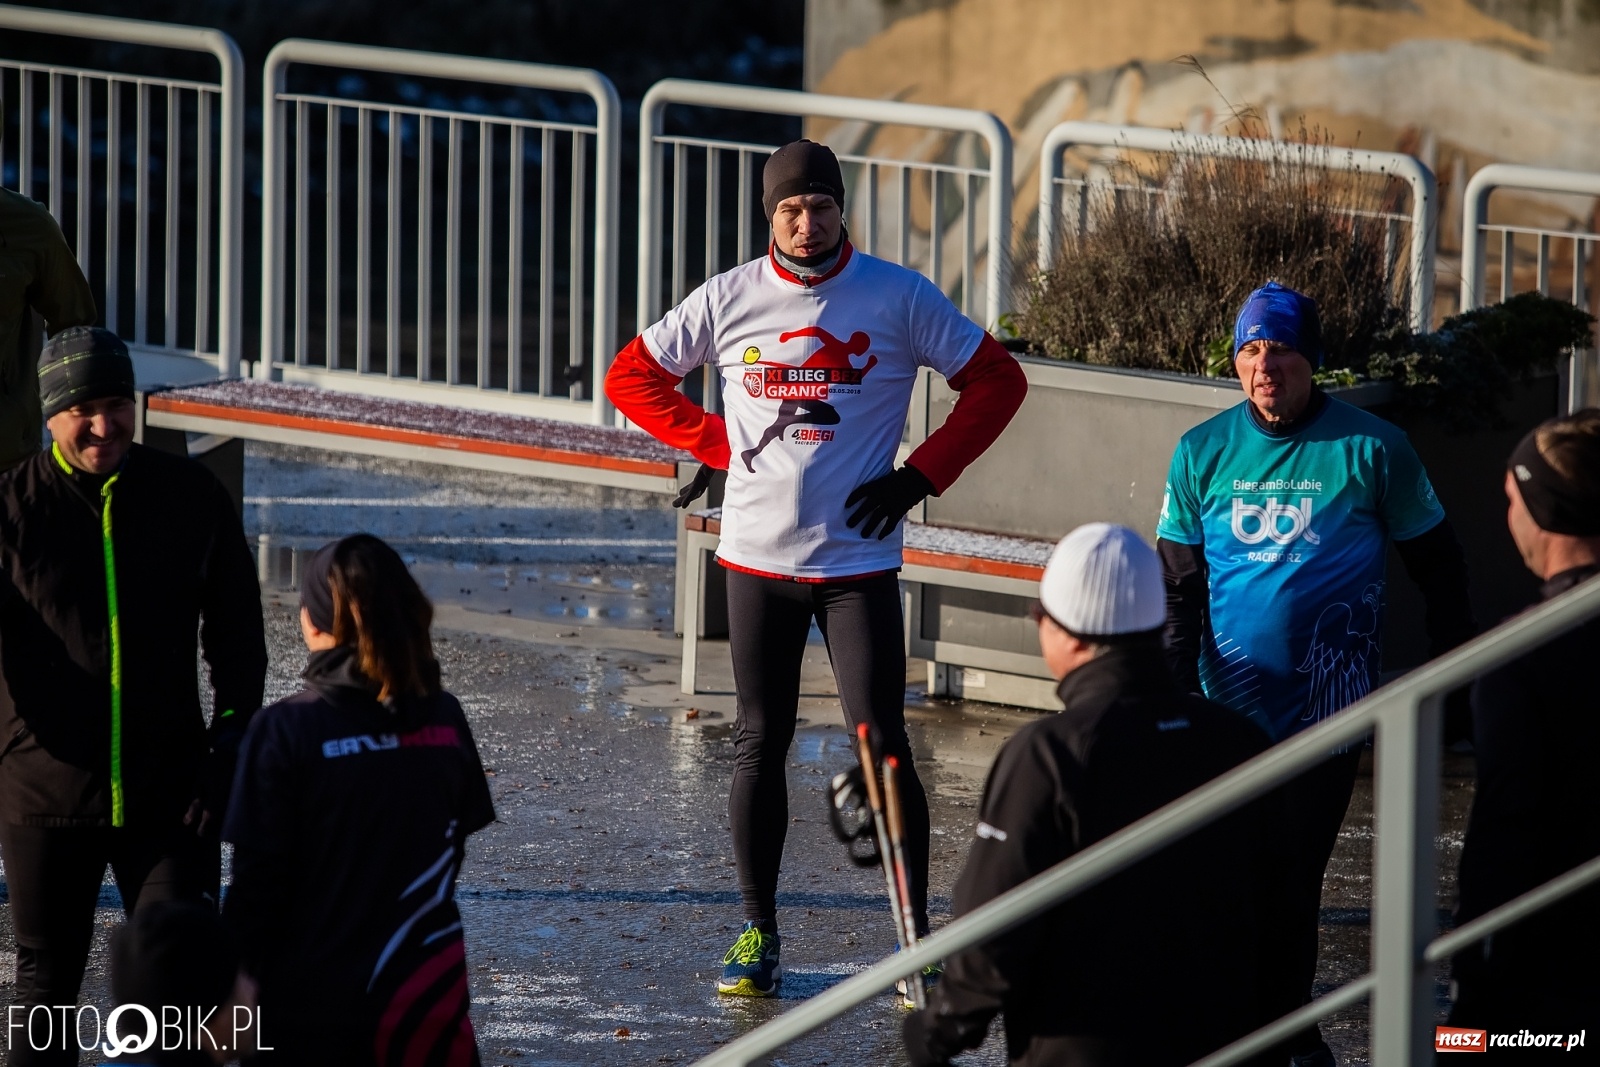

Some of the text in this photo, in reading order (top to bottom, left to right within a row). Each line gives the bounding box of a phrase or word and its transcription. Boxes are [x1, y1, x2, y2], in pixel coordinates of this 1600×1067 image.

[766, 369, 861, 382] XI BIEG BEZ
[767, 385, 827, 398] GRANIC
[1233, 479, 1323, 493] BiegamBoLubię
[1231, 497, 1321, 545] bbl
[1247, 550, 1302, 563] RACIBÓRZ
